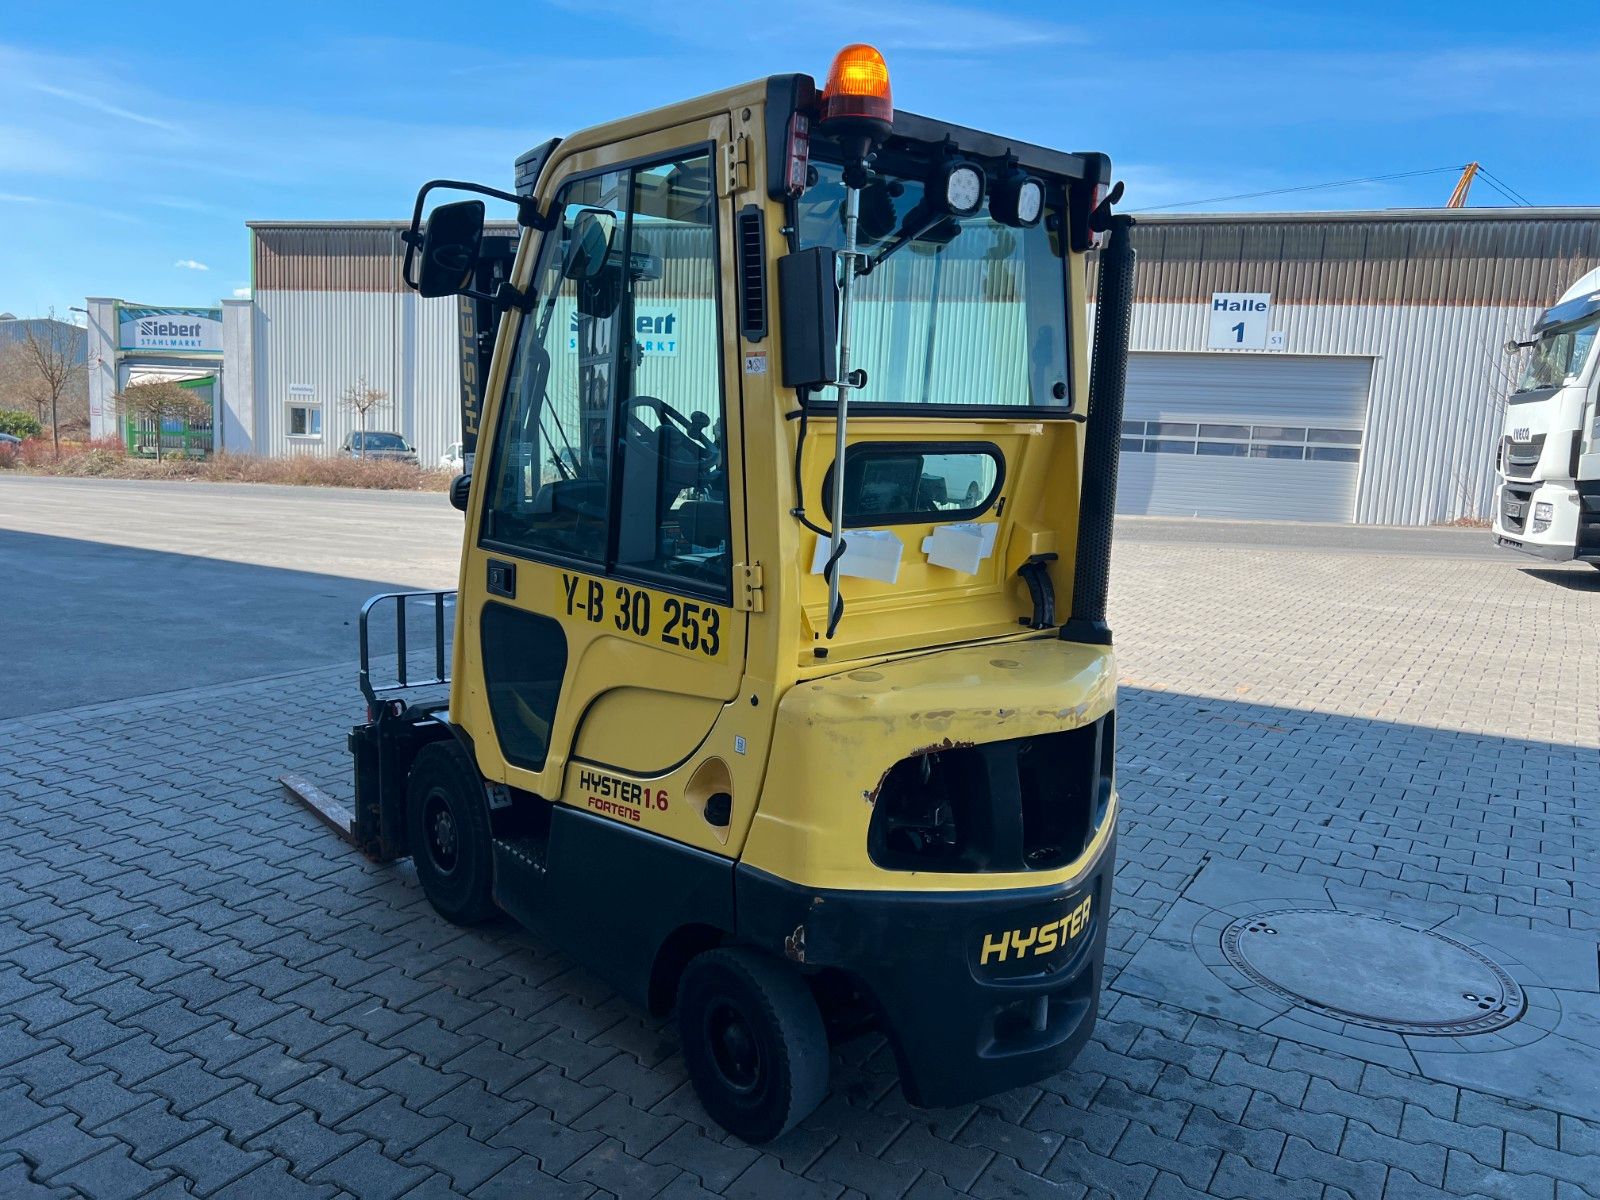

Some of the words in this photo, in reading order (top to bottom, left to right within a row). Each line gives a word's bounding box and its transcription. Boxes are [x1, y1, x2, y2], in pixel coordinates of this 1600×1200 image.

[1213, 298, 1267, 312] Halle
[140, 321, 202, 337] Siebert
[1231, 321, 1245, 343] 1
[141, 338, 202, 348] STAHLMARKT
[1513, 427, 1530, 440] IVECO
[562, 573, 604, 623] Y-B
[614, 586, 651, 637] 30
[661, 598, 720, 656] 253
[579, 770, 642, 806] HYSTER
[643, 788, 669, 812] 1.6
[588, 796, 641, 822] FORTENS
[980, 894, 1092, 965] HYSTER
